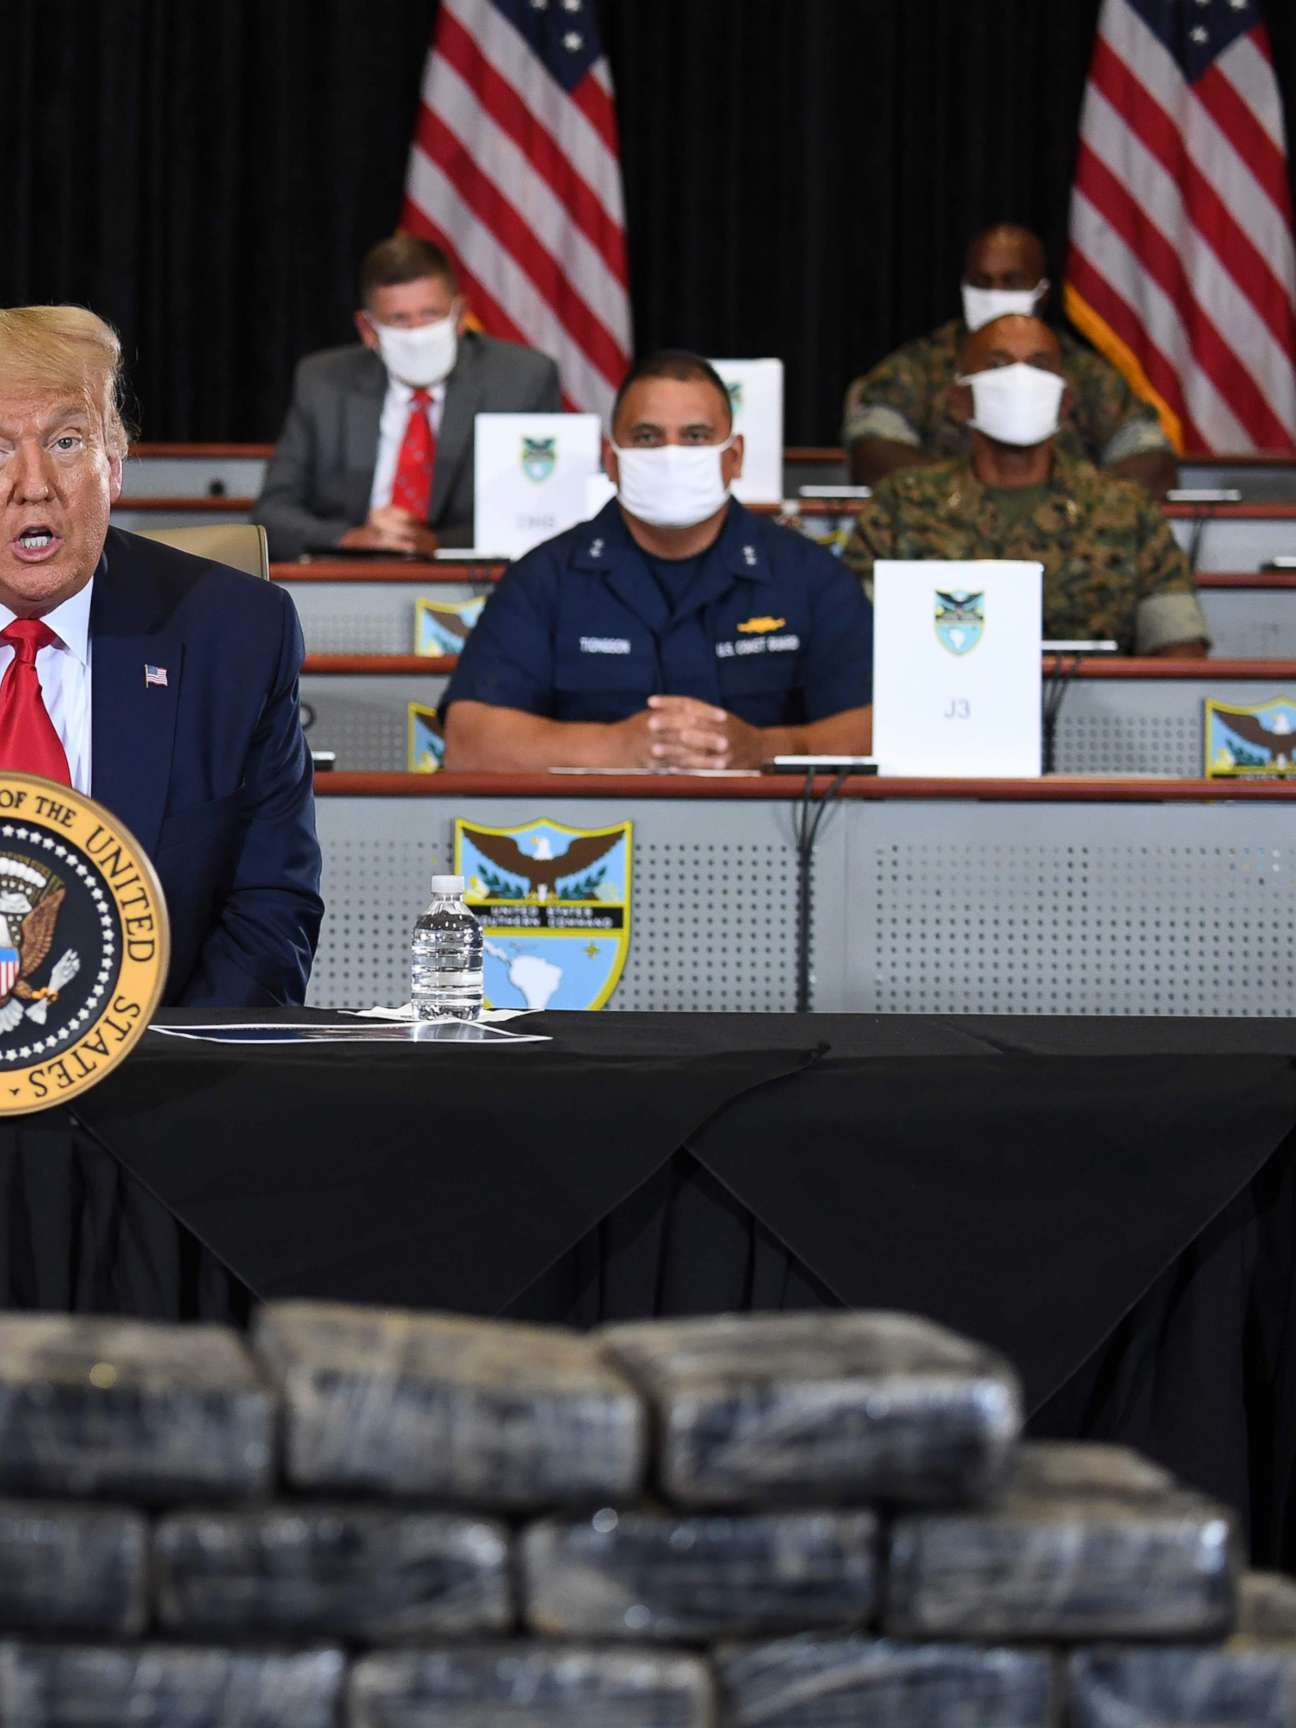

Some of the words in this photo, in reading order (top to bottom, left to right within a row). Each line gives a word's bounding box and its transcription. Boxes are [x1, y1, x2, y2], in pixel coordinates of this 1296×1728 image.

[944, 699, 971, 719] J3
[35, 795, 77, 828] THE
[85, 826, 156, 964] UNITED
[478, 916, 541, 926] OUTHERN
[547, 917, 613, 927] COMMAND
[491, 906, 539, 916] UNITED
[546, 907, 593, 917] STATES
[29, 995, 141, 1098] STATES
